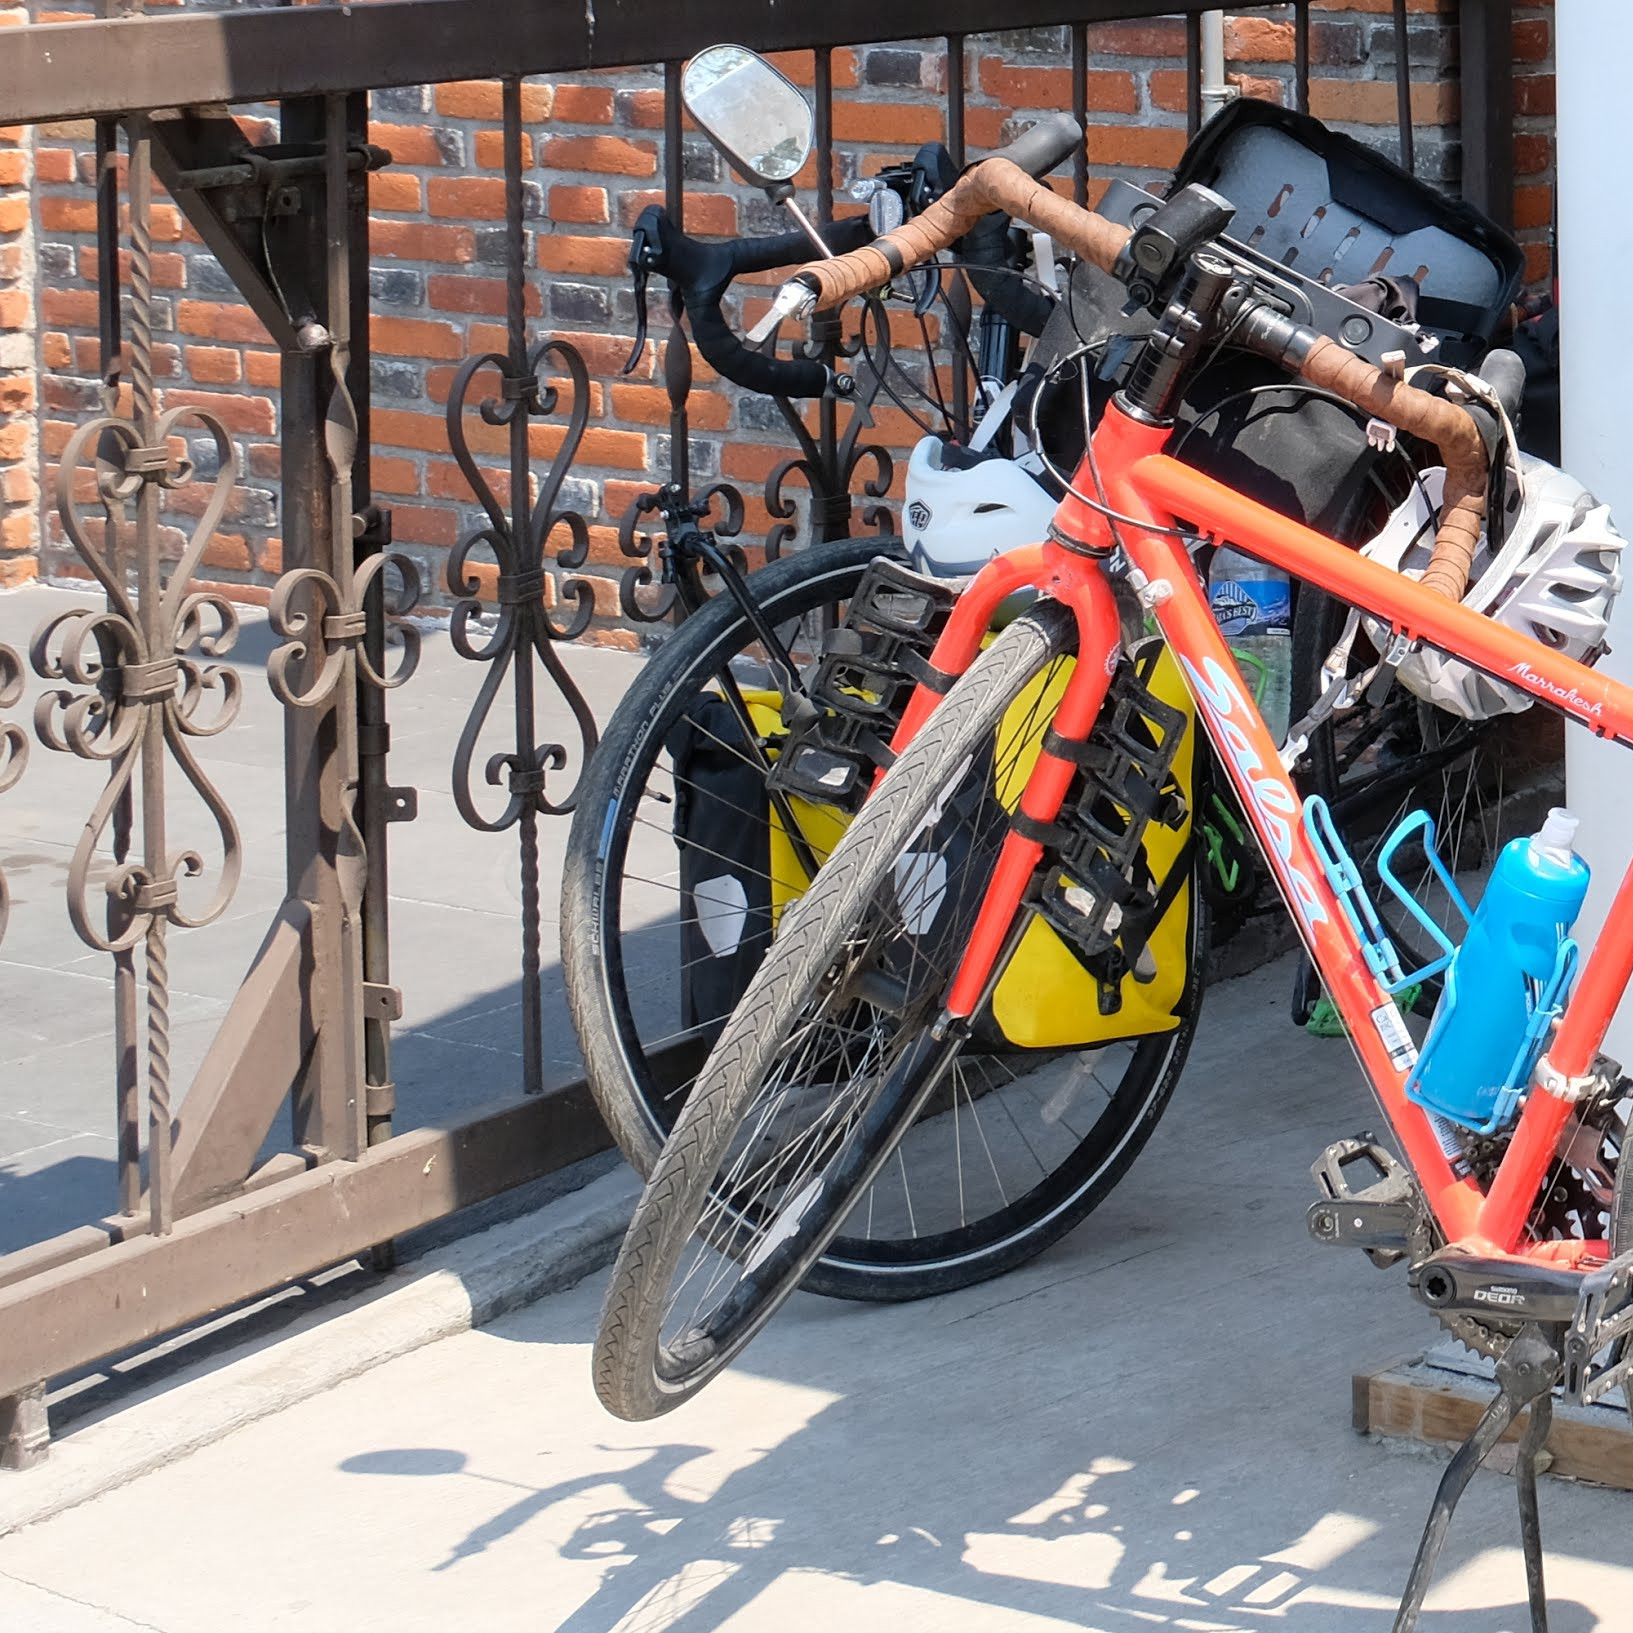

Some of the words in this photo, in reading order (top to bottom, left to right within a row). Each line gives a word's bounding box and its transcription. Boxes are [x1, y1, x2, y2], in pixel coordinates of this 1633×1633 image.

[613, 719, 649, 798] MARATHON
[649, 680, 673, 718] PLUS
[1507, 662, 1603, 716] Marrakesh
[1179, 652, 1329, 947] Salsa
